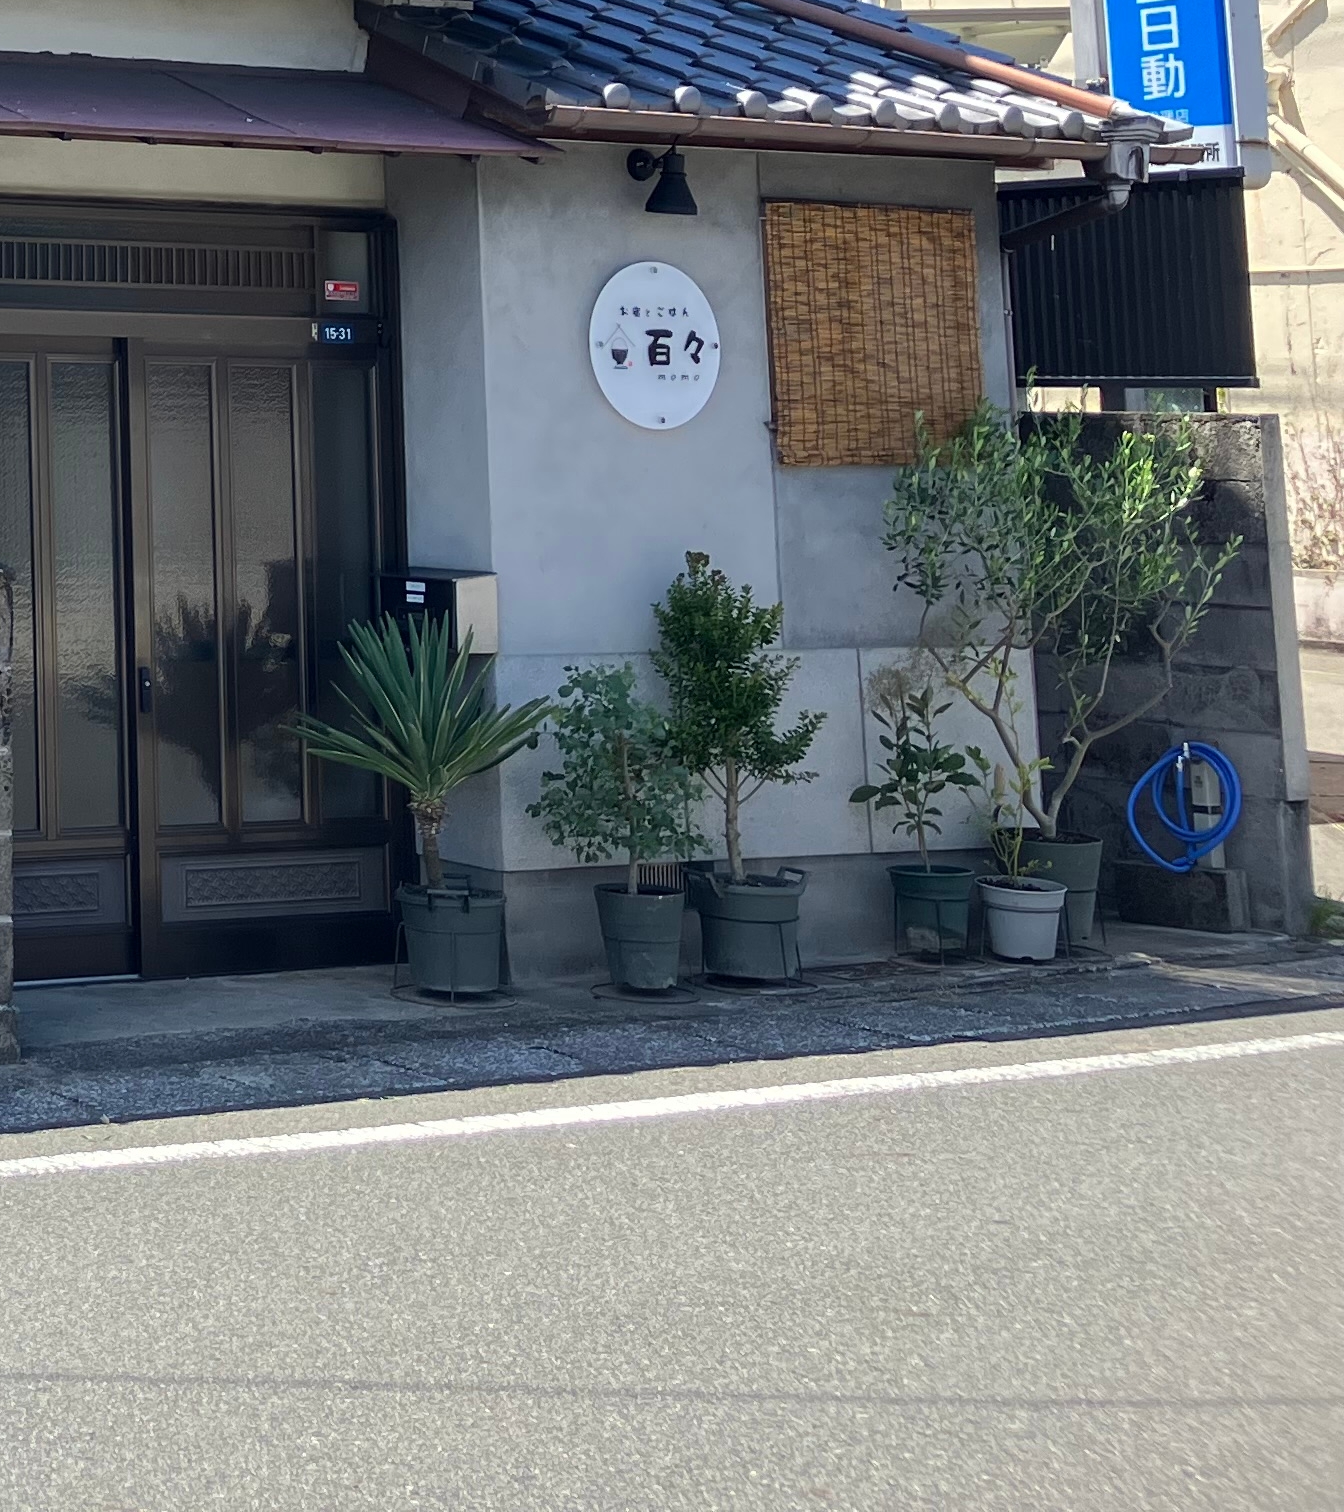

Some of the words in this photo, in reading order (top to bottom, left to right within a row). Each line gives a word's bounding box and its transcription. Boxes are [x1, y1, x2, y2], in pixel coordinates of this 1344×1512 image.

[324, 327, 352, 340] 15-31
[644, 328, 705, 367] 百々
[657, 373, 700, 382] momo
